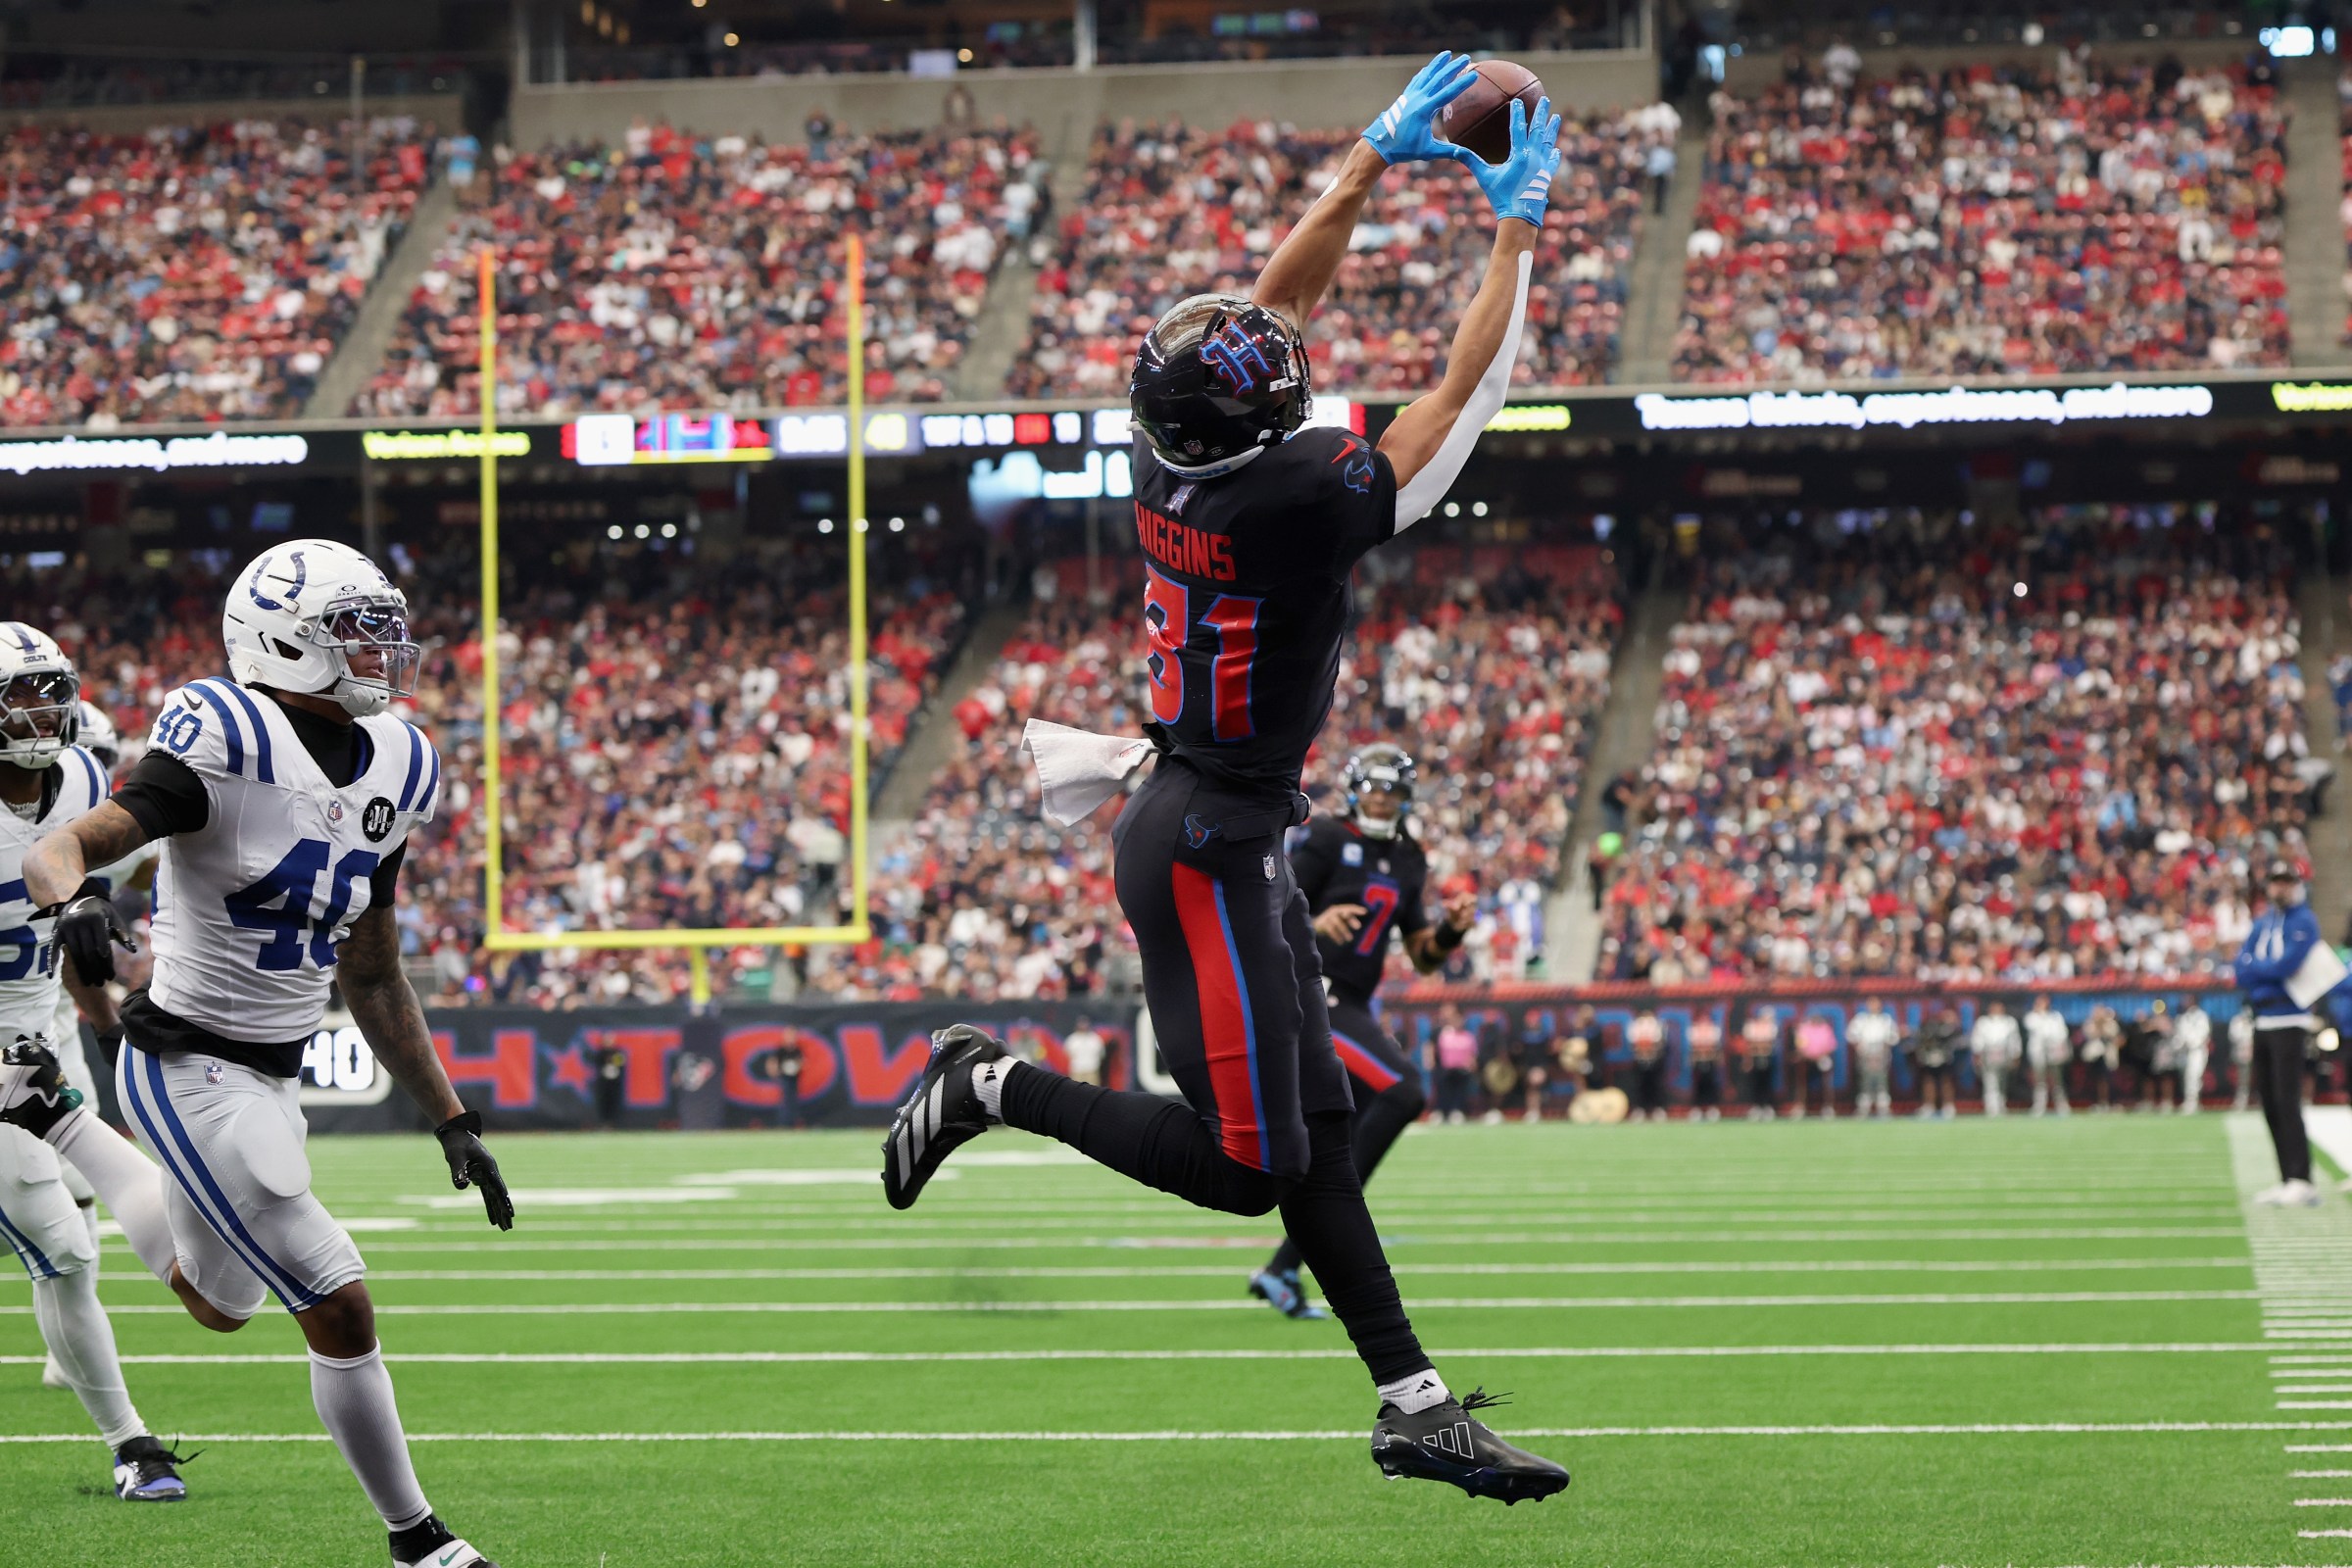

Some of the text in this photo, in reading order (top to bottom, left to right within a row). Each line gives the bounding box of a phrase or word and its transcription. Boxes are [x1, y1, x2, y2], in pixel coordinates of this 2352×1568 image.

[1135, 500, 1237, 581] HIGGINS
[156, 705, 203, 754] 40
[223, 837, 380, 970] 40
[1355, 883, 1399, 956] 7
